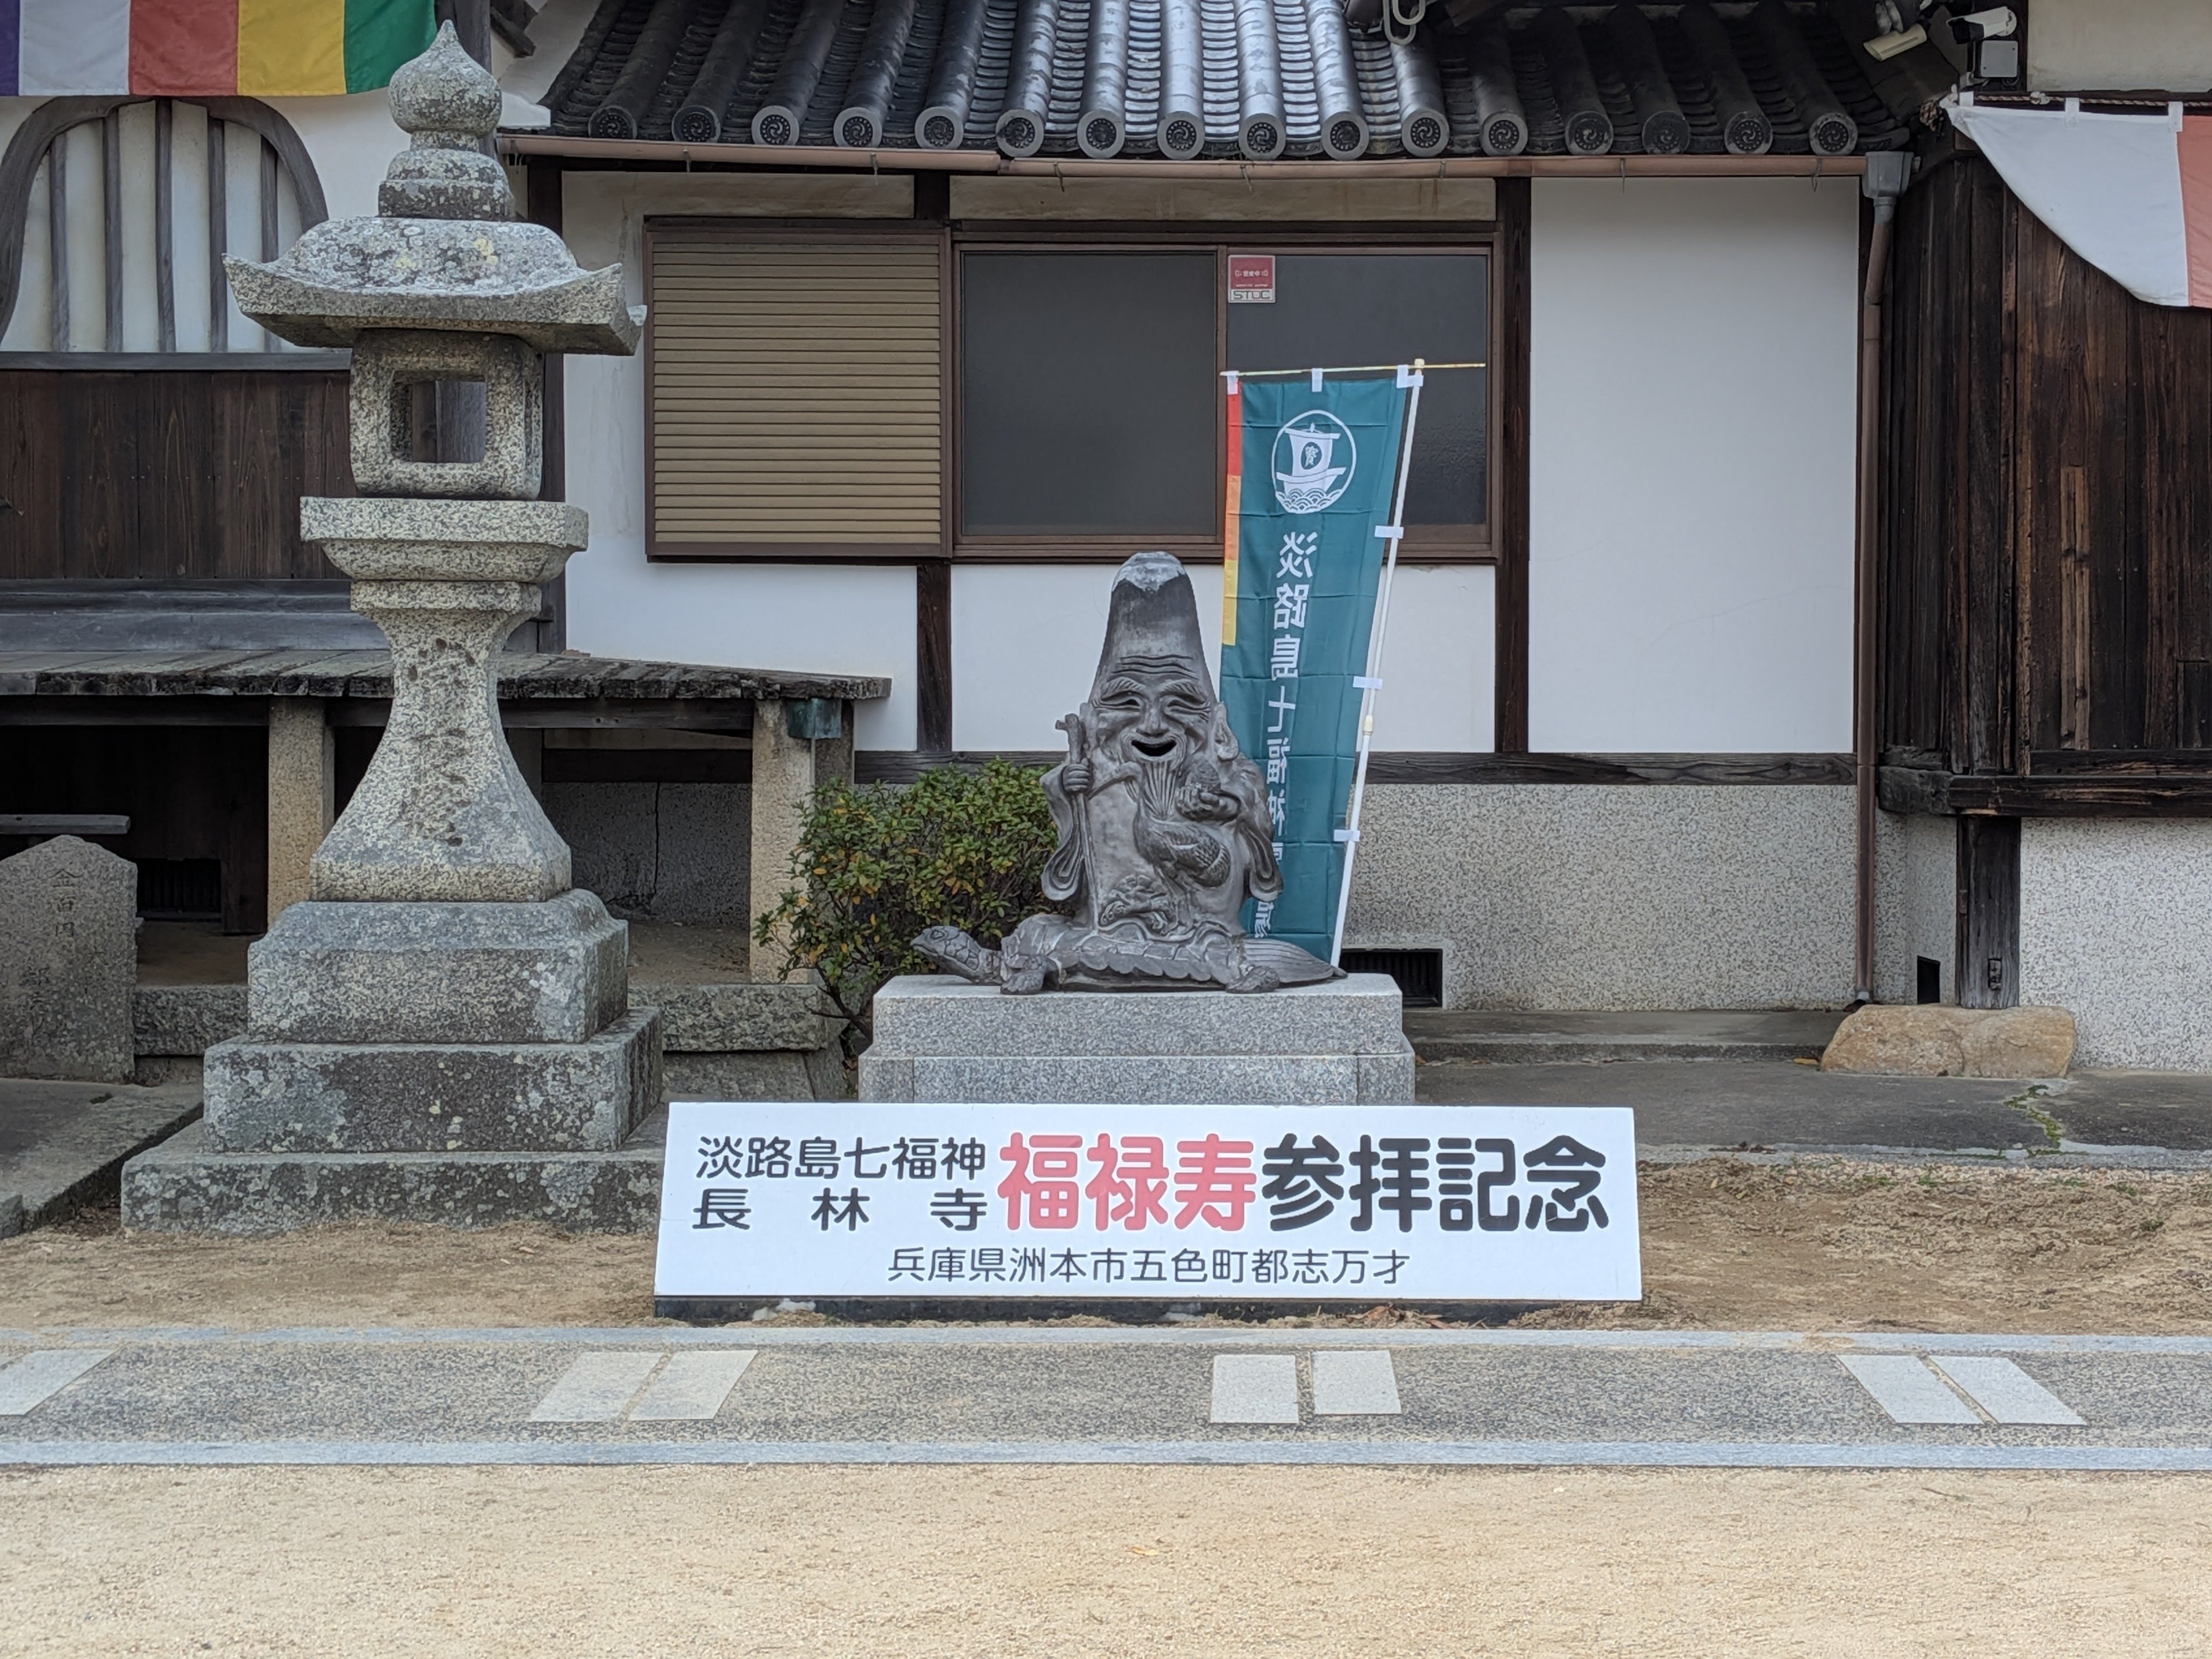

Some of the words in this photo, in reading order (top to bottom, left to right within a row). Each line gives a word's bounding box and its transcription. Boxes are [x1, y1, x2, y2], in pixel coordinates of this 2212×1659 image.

[696, 1135, 986, 1181] 淡路島七福神
[997, 1132, 1610, 1233] 福禄寿参拝記念
[888, 1246, 1411, 1284] 兵庫県洲本市五色町都志万才
